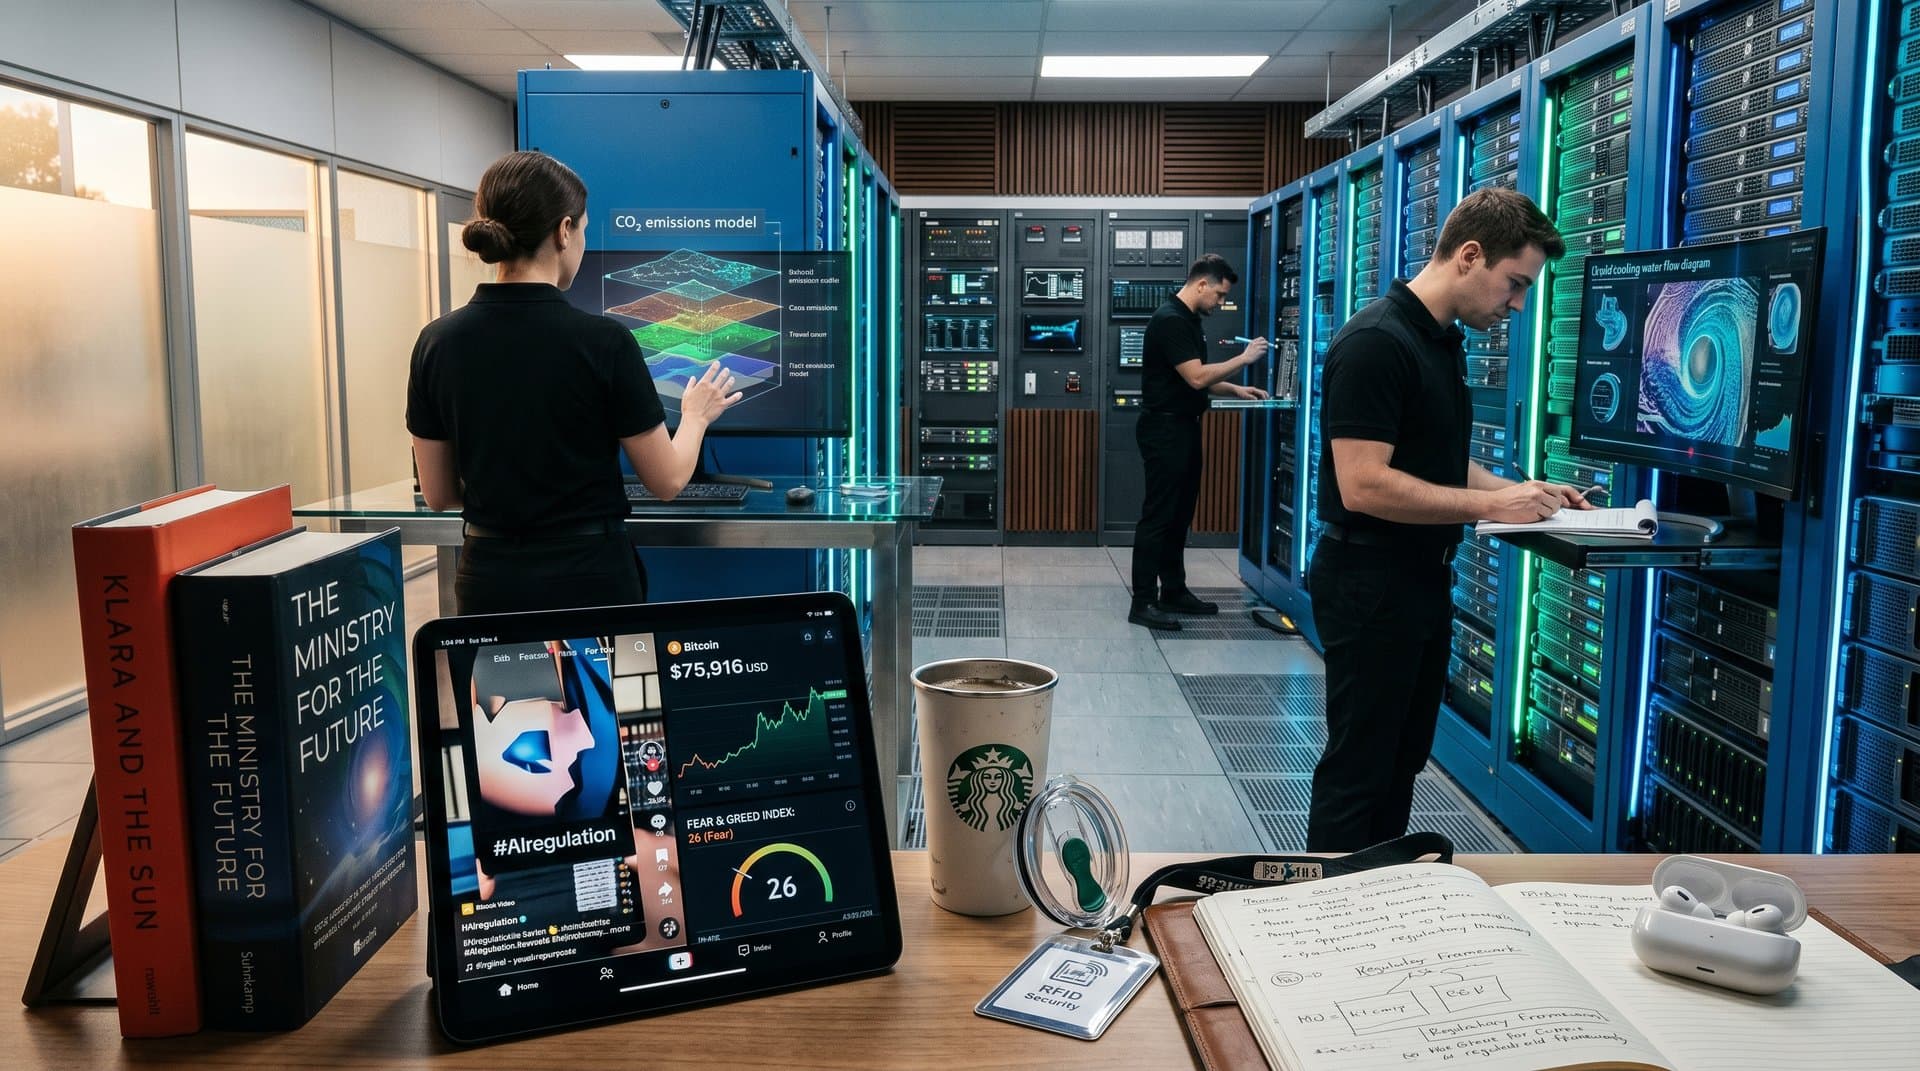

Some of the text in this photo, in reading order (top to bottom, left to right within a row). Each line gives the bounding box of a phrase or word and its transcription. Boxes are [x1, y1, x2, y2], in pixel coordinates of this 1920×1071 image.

[645, 216, 711, 229] emissions
[715, 215, 757, 229] model
[1613, 263, 1640, 277] cooling
[1641, 262, 1662, 273] water
[1663, 260, 1680, 271] flow
[1681, 258, 1711, 273] diagram
[290, 580, 341, 628] THE
[294, 601, 396, 678] MINISTRY
[684, 640, 719, 652] Bitcoin
[584, 647, 599, 656] For
[670, 658, 769, 681] $75,916 USD
[297, 652, 384, 725] FOR THE
[299, 695, 385, 773] FUTURE
[102, 574, 158, 931] KLARA AND THE SUN
[231, 653, 266, 899] THE MINISTRY FOR
[207, 712, 239, 892] THE FUTURE
[686, 806, 796, 830] FEAR & GREED INDEX:
[688, 828, 734, 844] 26 (Fear)
[766, 875, 798, 901] 26
[610, 924, 631, 935] more
[831, 929, 853, 939] Profile
[517, 981, 539, 992] Home
[1039, 984, 1083, 1001] RFID
[1024, 992, 1081, 1011] Security
